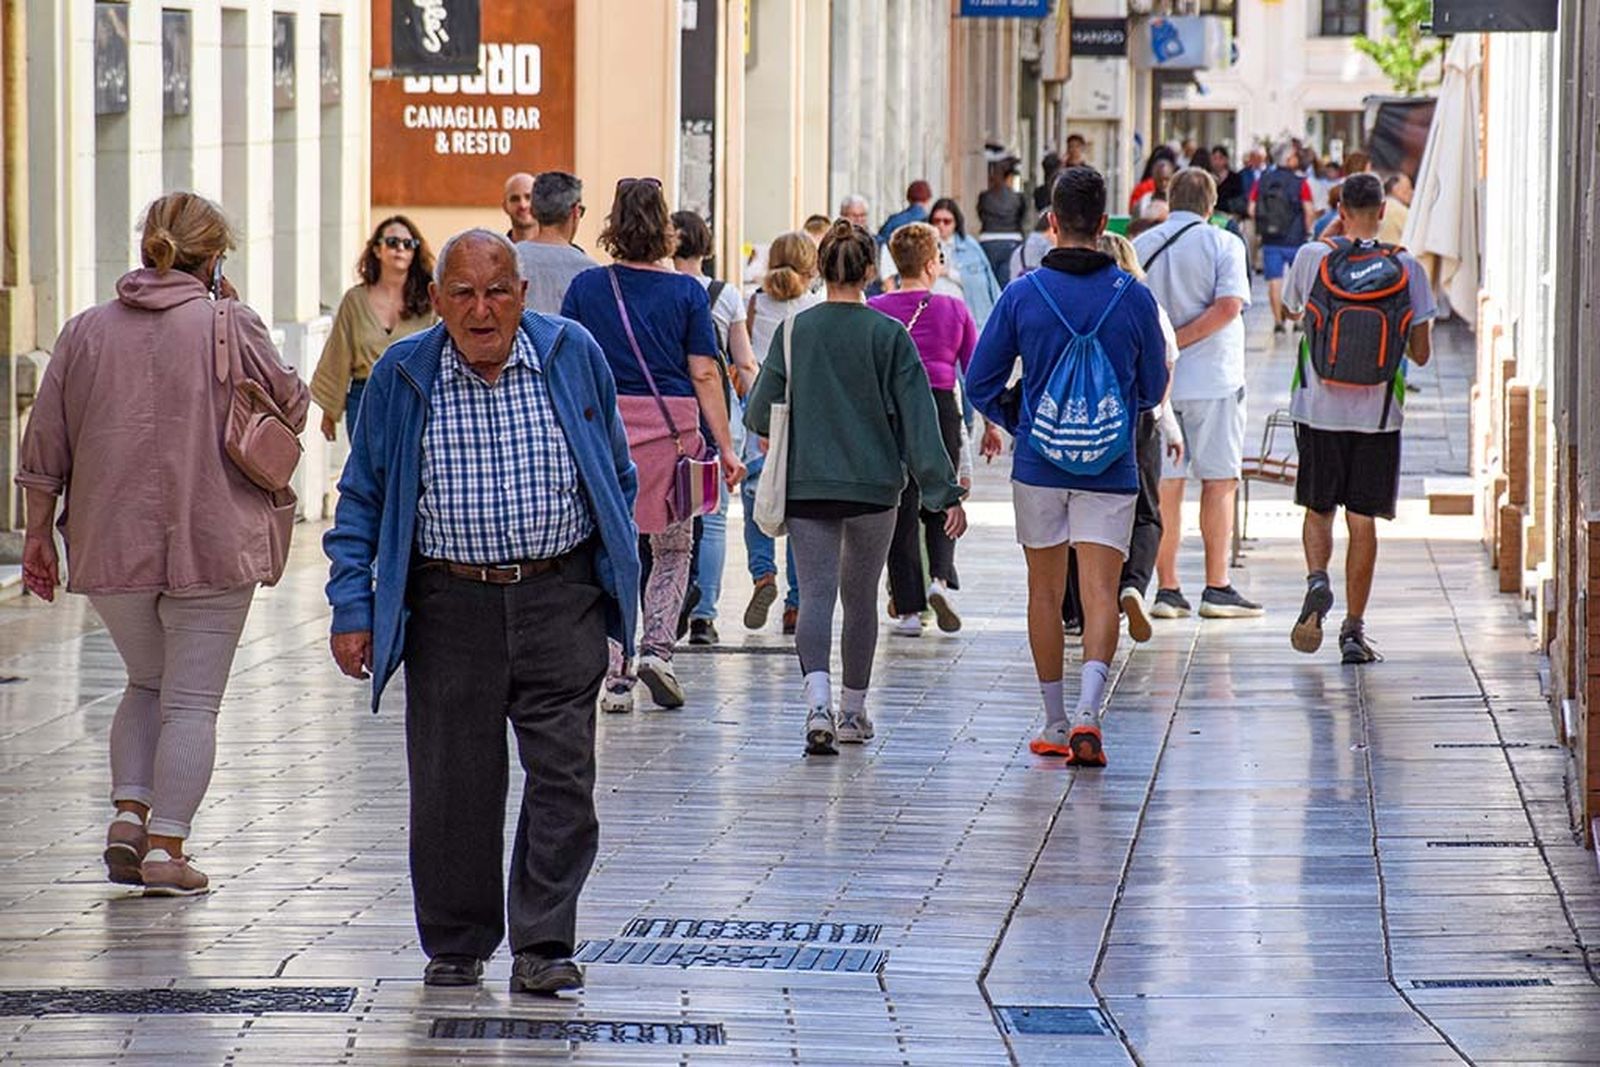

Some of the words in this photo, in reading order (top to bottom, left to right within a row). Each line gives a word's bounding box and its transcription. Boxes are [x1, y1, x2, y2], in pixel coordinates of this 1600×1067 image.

[404, 104, 498, 129] CANAGLIA
[502, 106, 541, 130] BAR
[435, 131, 450, 154] &
[452, 131, 511, 155] RESTO
